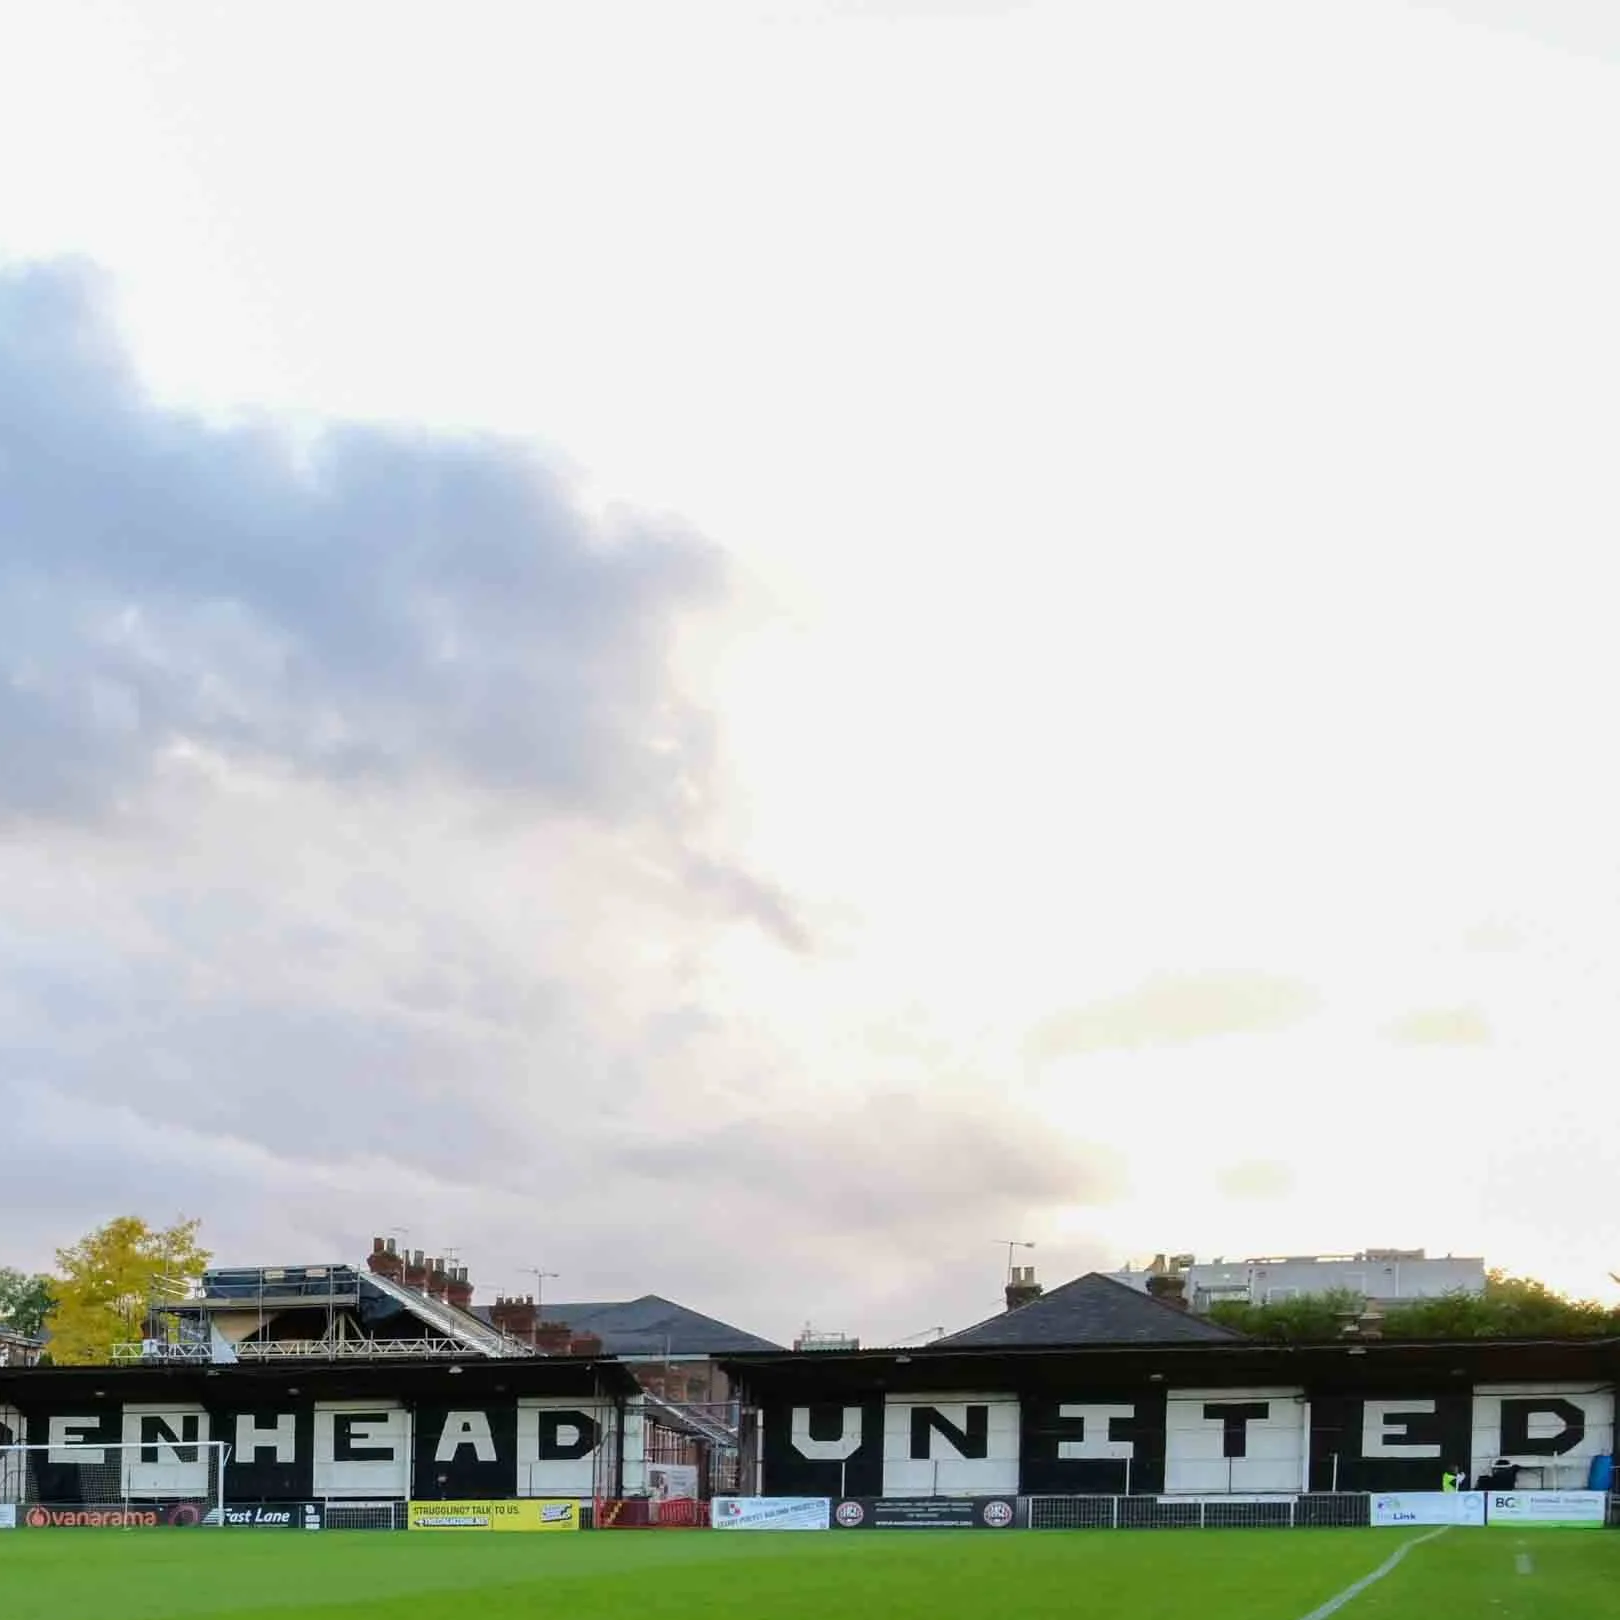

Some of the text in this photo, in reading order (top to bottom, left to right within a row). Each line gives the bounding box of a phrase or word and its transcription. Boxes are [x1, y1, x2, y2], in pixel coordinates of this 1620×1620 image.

[791, 1398, 1585, 1460] UNITED
[51, 1509, 156, 1526] vanarama
[256, 1507, 290, 1523] Lane
[495, 1506, 505, 1514] TO
